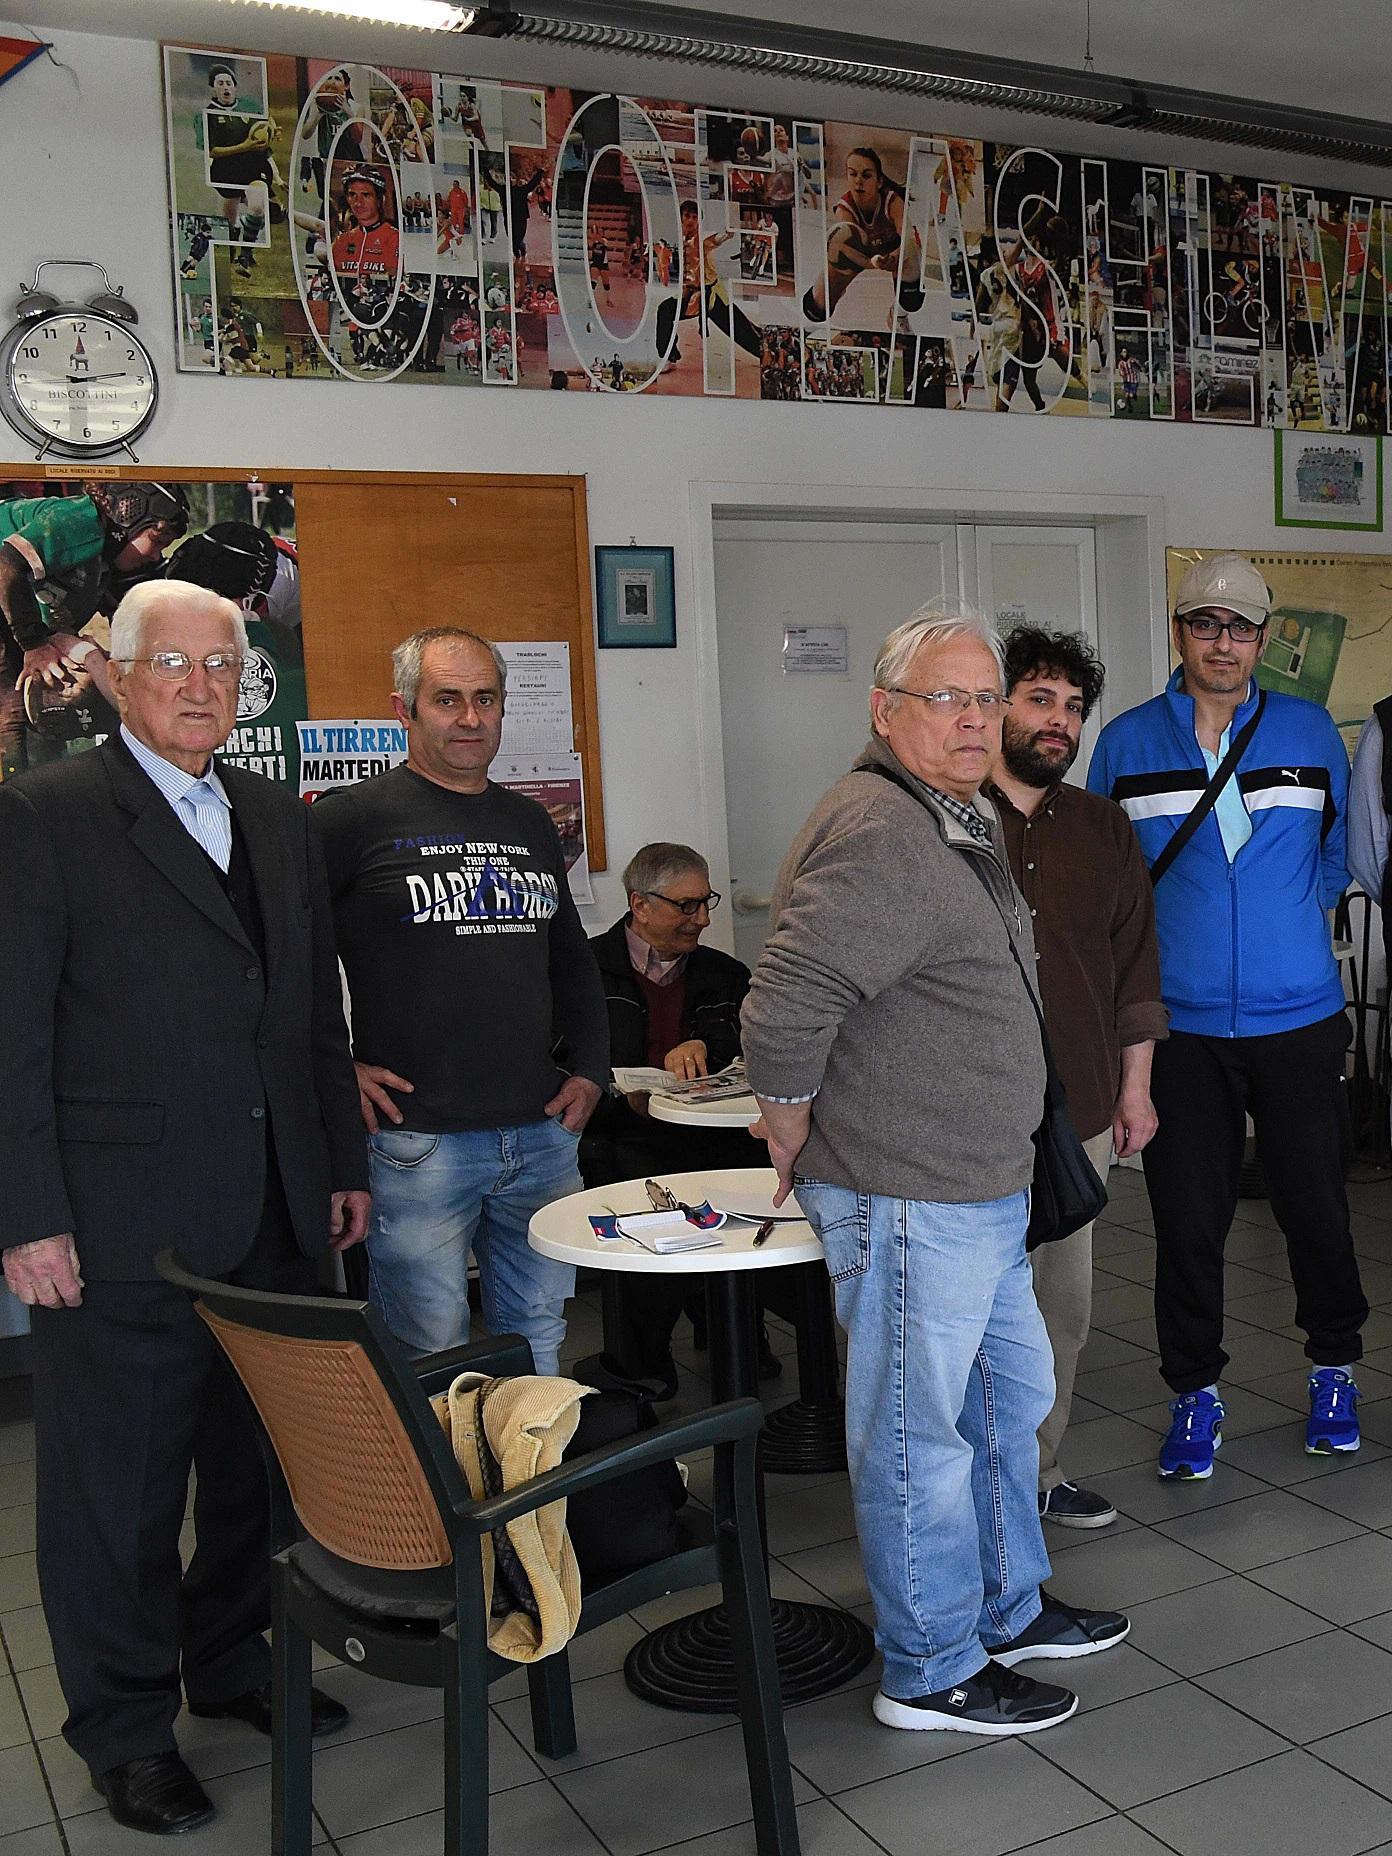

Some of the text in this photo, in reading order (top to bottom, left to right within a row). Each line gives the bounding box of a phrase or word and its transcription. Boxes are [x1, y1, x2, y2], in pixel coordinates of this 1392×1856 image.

[363, 262, 385, 272] BIKE
[72, 322, 88, 333] 12
[43, 329, 112, 341] 11 1
[23, 347, 136, 361] 10 2
[136, 376, 145, 387] 3
[53, 419, 61, 431] 7
[83, 427, 92, 439] 6
[996, 611, 1026, 619] LOCALE
[301, 727, 409, 754] IL TIRREN
[420, 842, 531, 857] ENJOY NEW YORK
[489, 856, 510, 866] ONE
[406, 872, 489, 924] DARK
[455, 925, 482, 936] SIMPLE
[483, 925, 497, 934] AND
